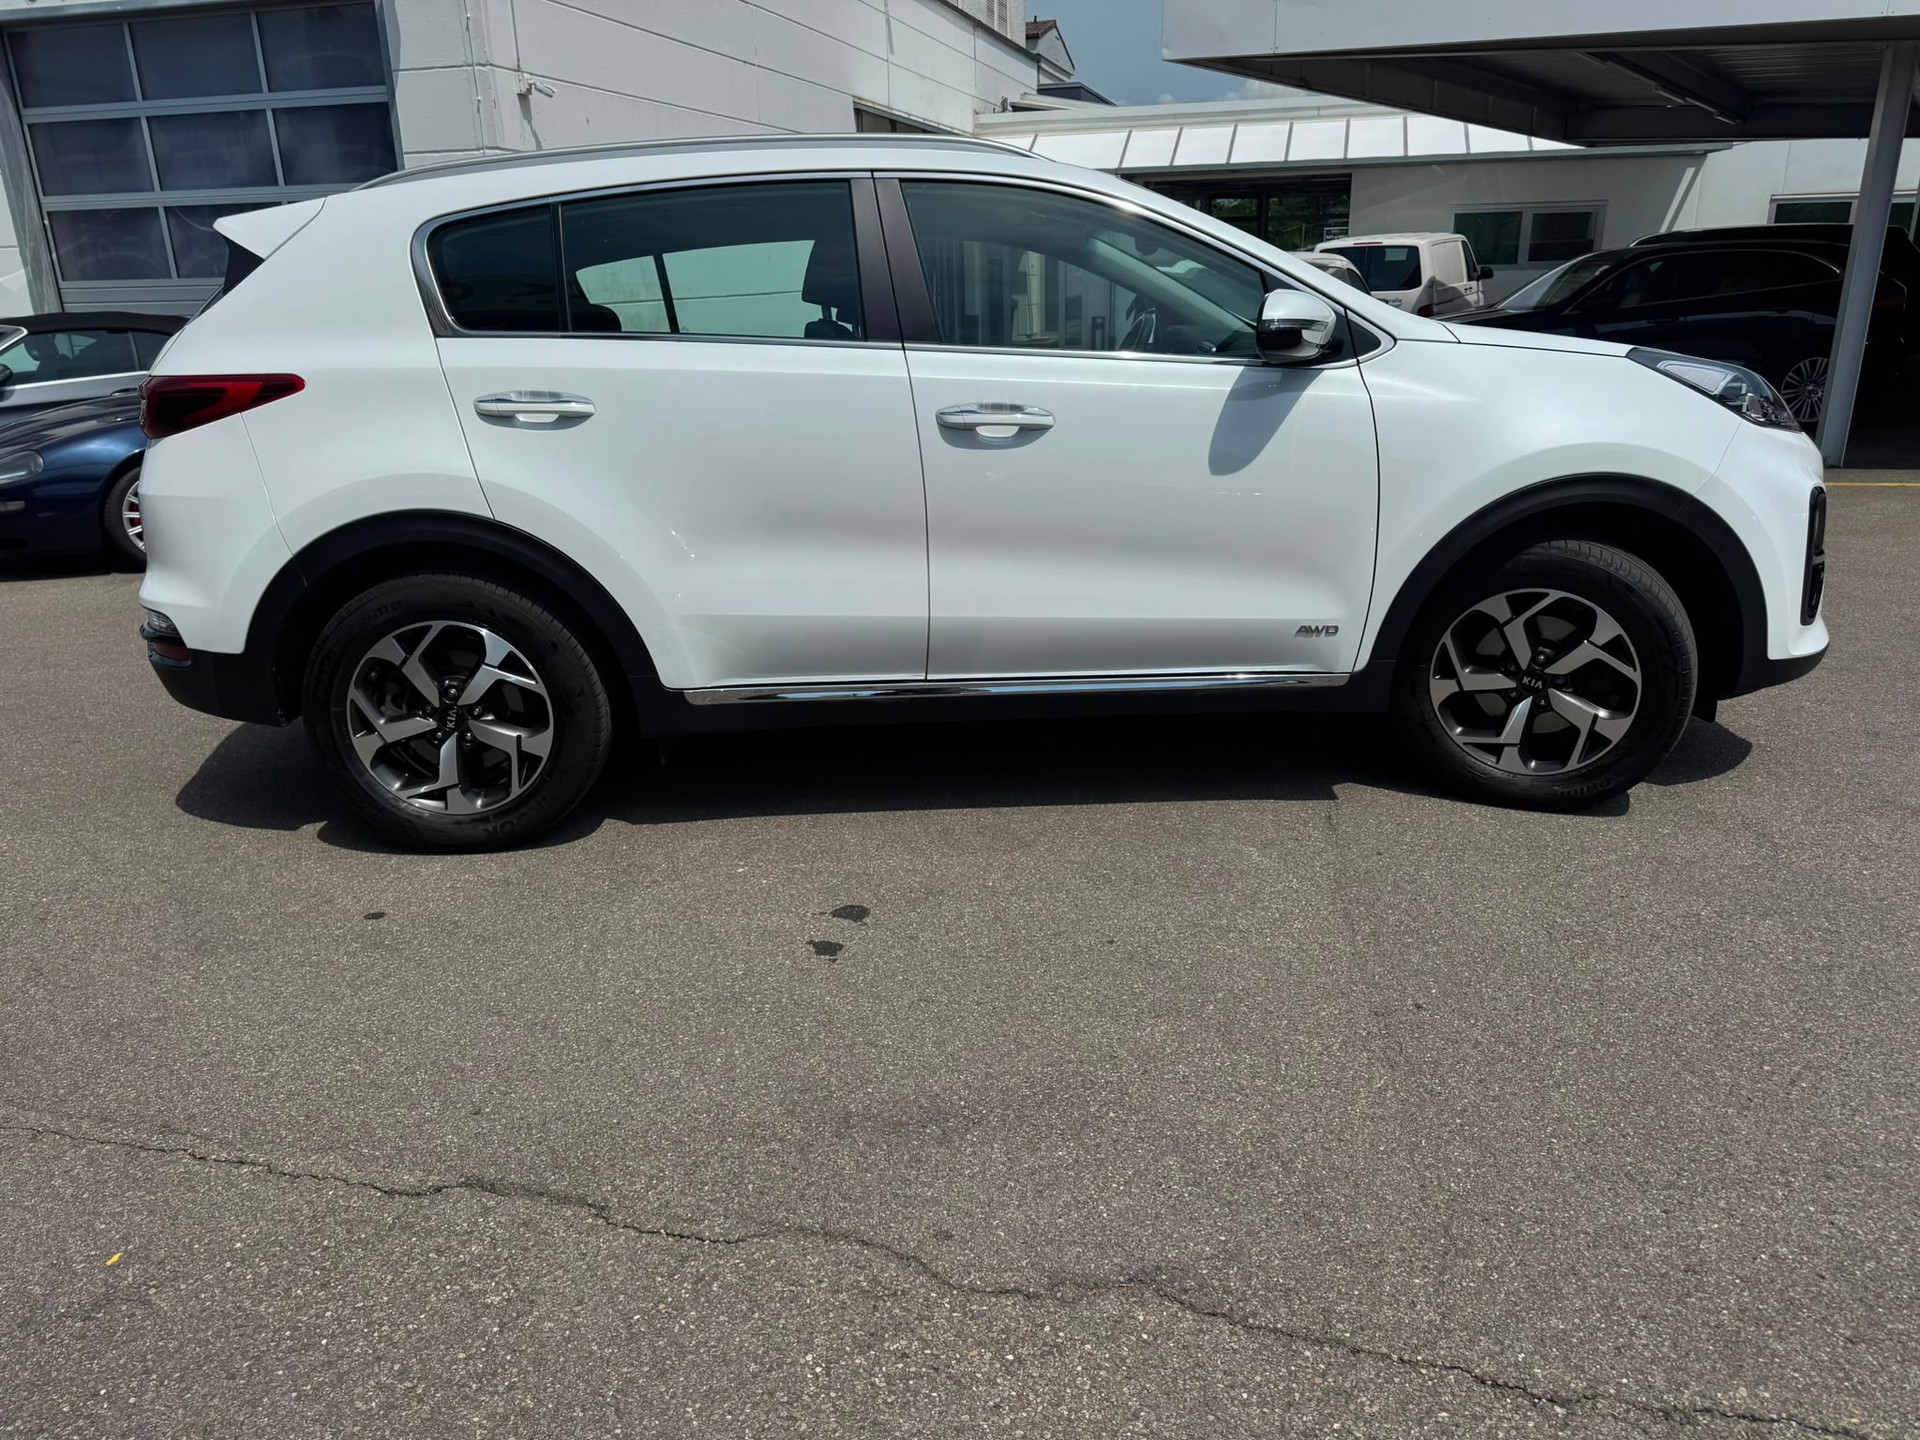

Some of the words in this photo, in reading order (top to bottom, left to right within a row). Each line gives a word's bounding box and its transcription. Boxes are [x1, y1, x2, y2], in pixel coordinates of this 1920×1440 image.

[1294, 625, 1339, 638] AWD
[1522, 676, 1542, 689] KIA
[446, 709, 457, 728] KIA
